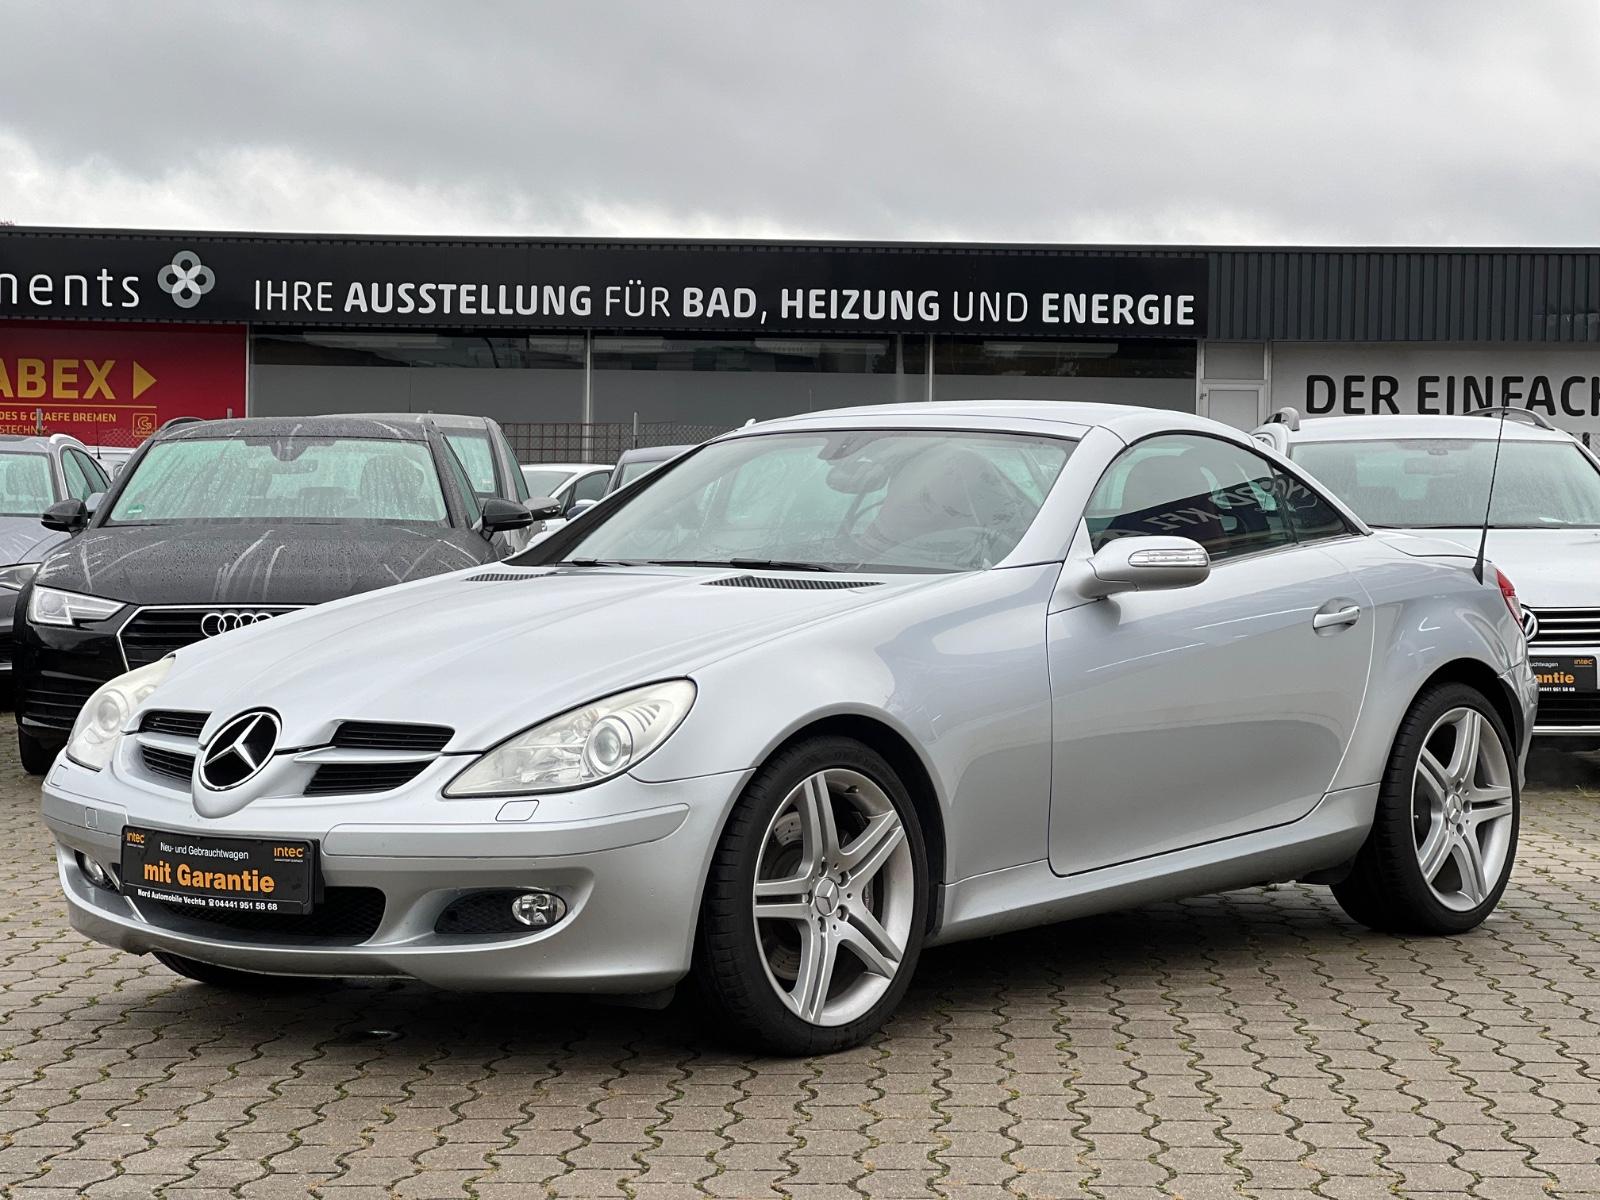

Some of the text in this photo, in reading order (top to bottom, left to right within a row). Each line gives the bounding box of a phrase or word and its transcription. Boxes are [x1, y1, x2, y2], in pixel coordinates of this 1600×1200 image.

[254, 279, 1195, 326] IHRE AUSSTELLUNG FÜR BAD, HEIZUNG UND ENERGIE
[1306, 375, 1399, 415] DER
[20, 411, 27, 421] &
[72, 412, 117, 423] BREMEN
[0, 424, 48, 435] STECHNK
[160, 842, 249, 861] Neu- und Gebrauchtwagen
[273, 847, 304, 858] intec
[144, 861, 275, 893] mit Garantie
[137, 888, 278, 911] Nord Automobile Vechta 04441 951 58 68
